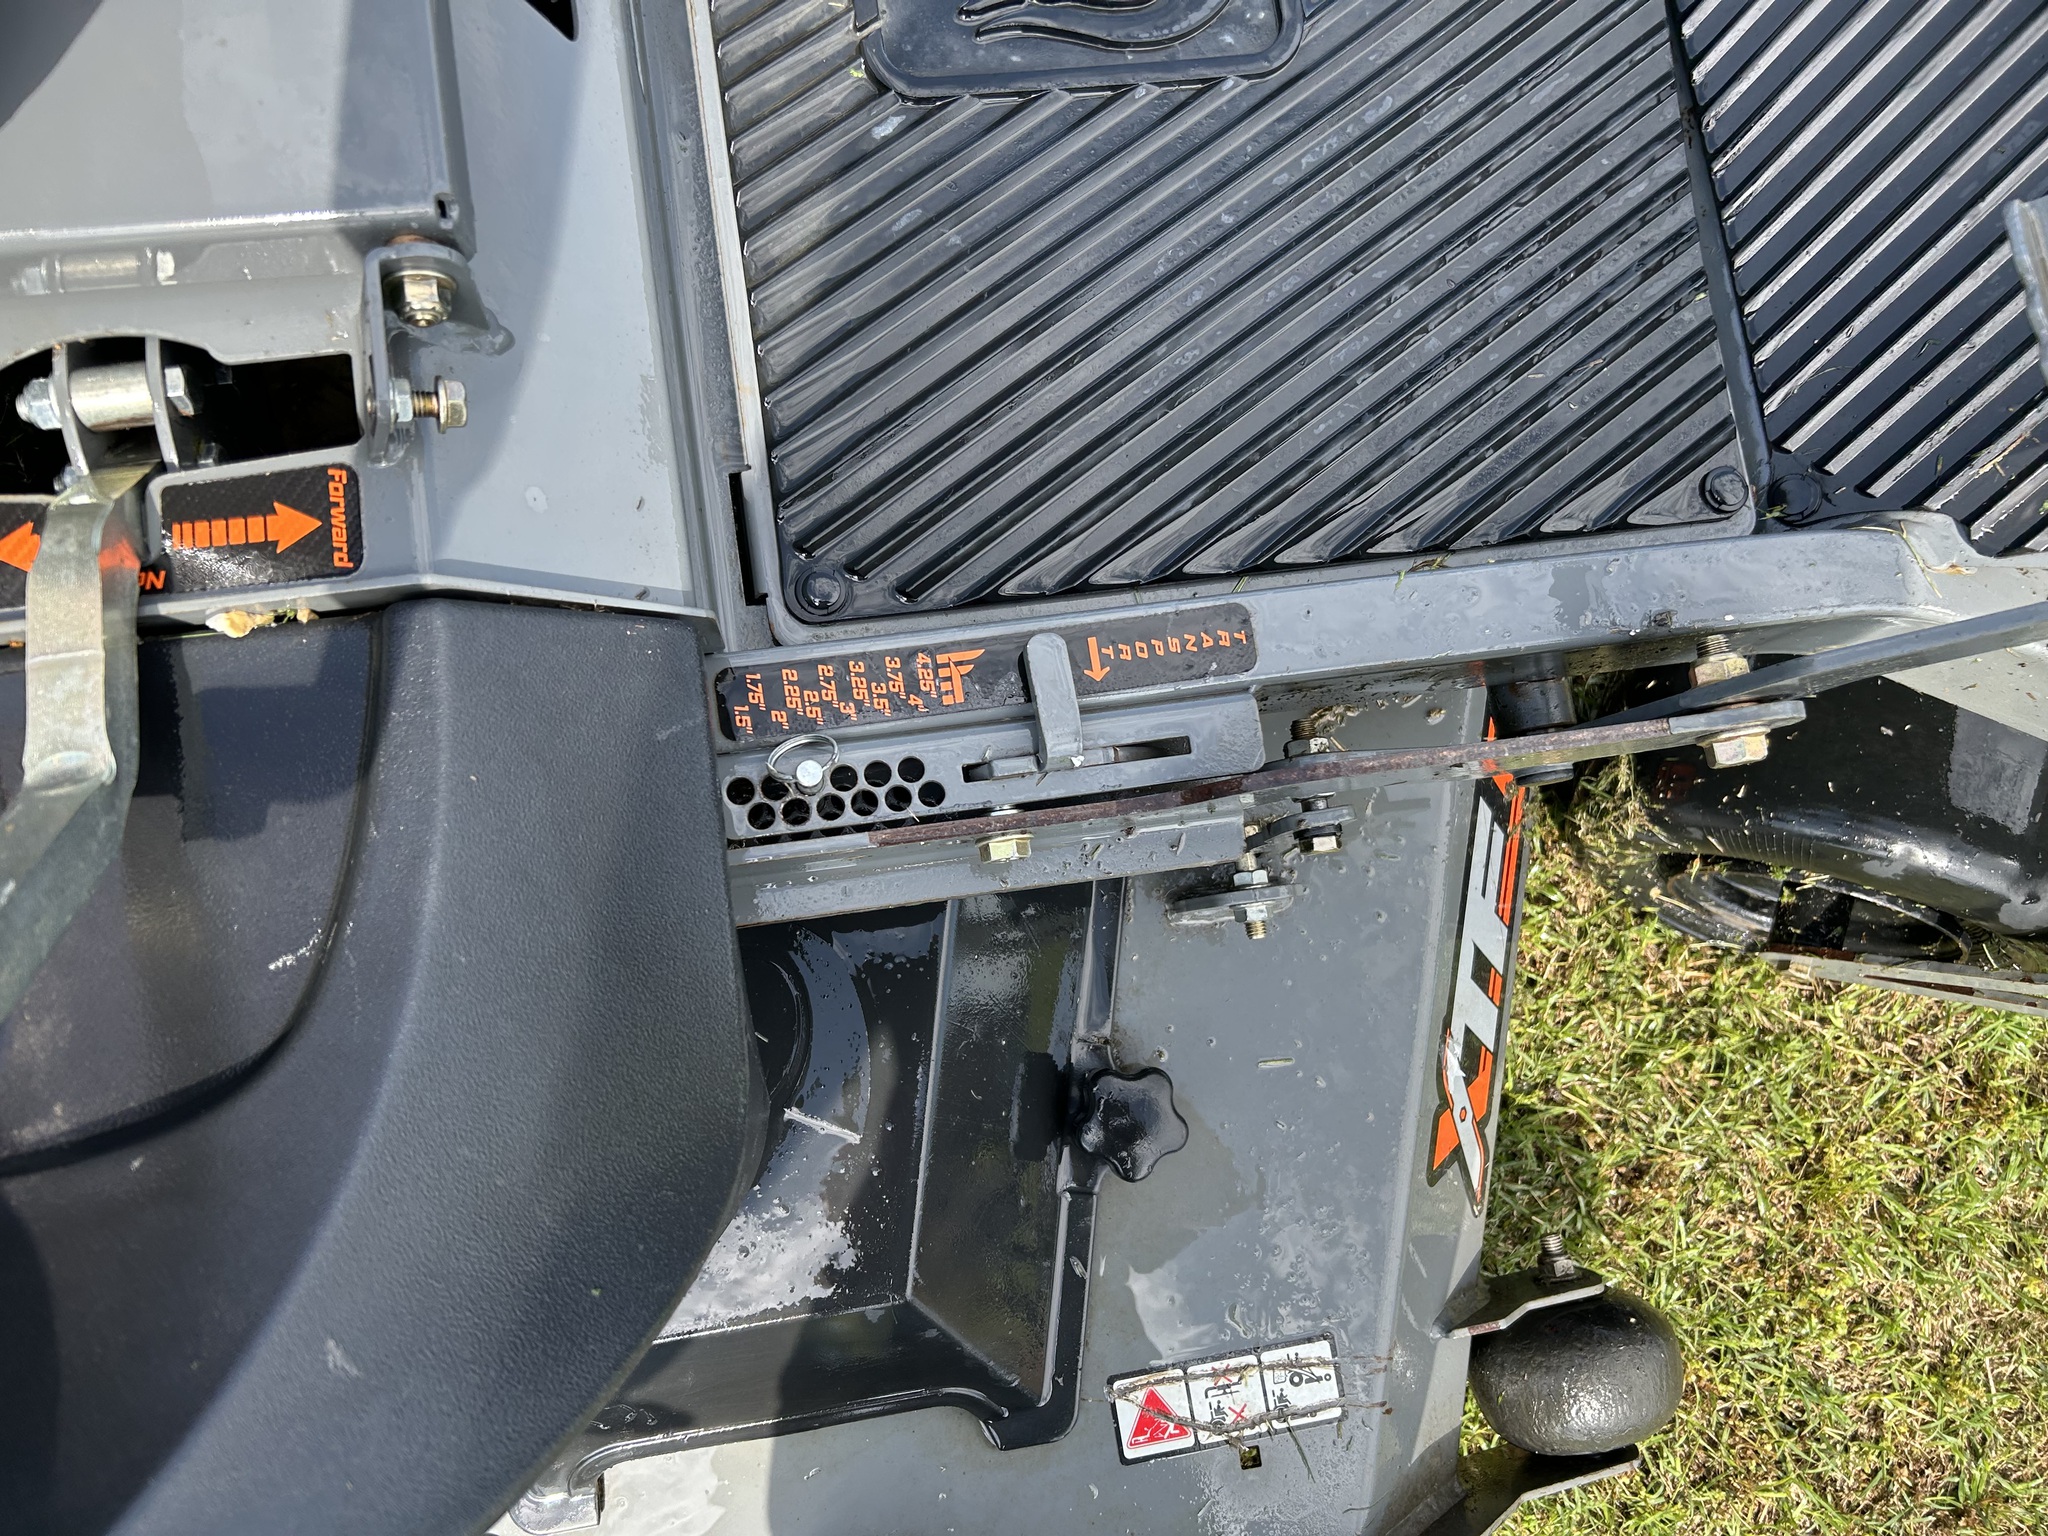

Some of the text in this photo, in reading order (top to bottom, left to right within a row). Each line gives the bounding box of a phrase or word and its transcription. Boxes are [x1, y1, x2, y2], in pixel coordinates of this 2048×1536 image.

[327, 467, 354, 569] Forward
[1101, 620, 1247, 661] TRANSPORT
[745, 673, 767, 711] 1.75"
[781, 668, 804, 716] 2.25"
[817, 664, 839, 708] 2.75"
[848, 660, 871, 707] 3.25"
[884, 656, 907, 699] 3.75"
[916, 652, 938, 698] 4.25"
[733, 705, 754, 734] 1.5"
[770, 710, 790, 730] 2"
[803, 690, 824, 725] 2.5"
[839, 701, 858, 721] 3"
[870, 682, 892, 717] 3.5"
